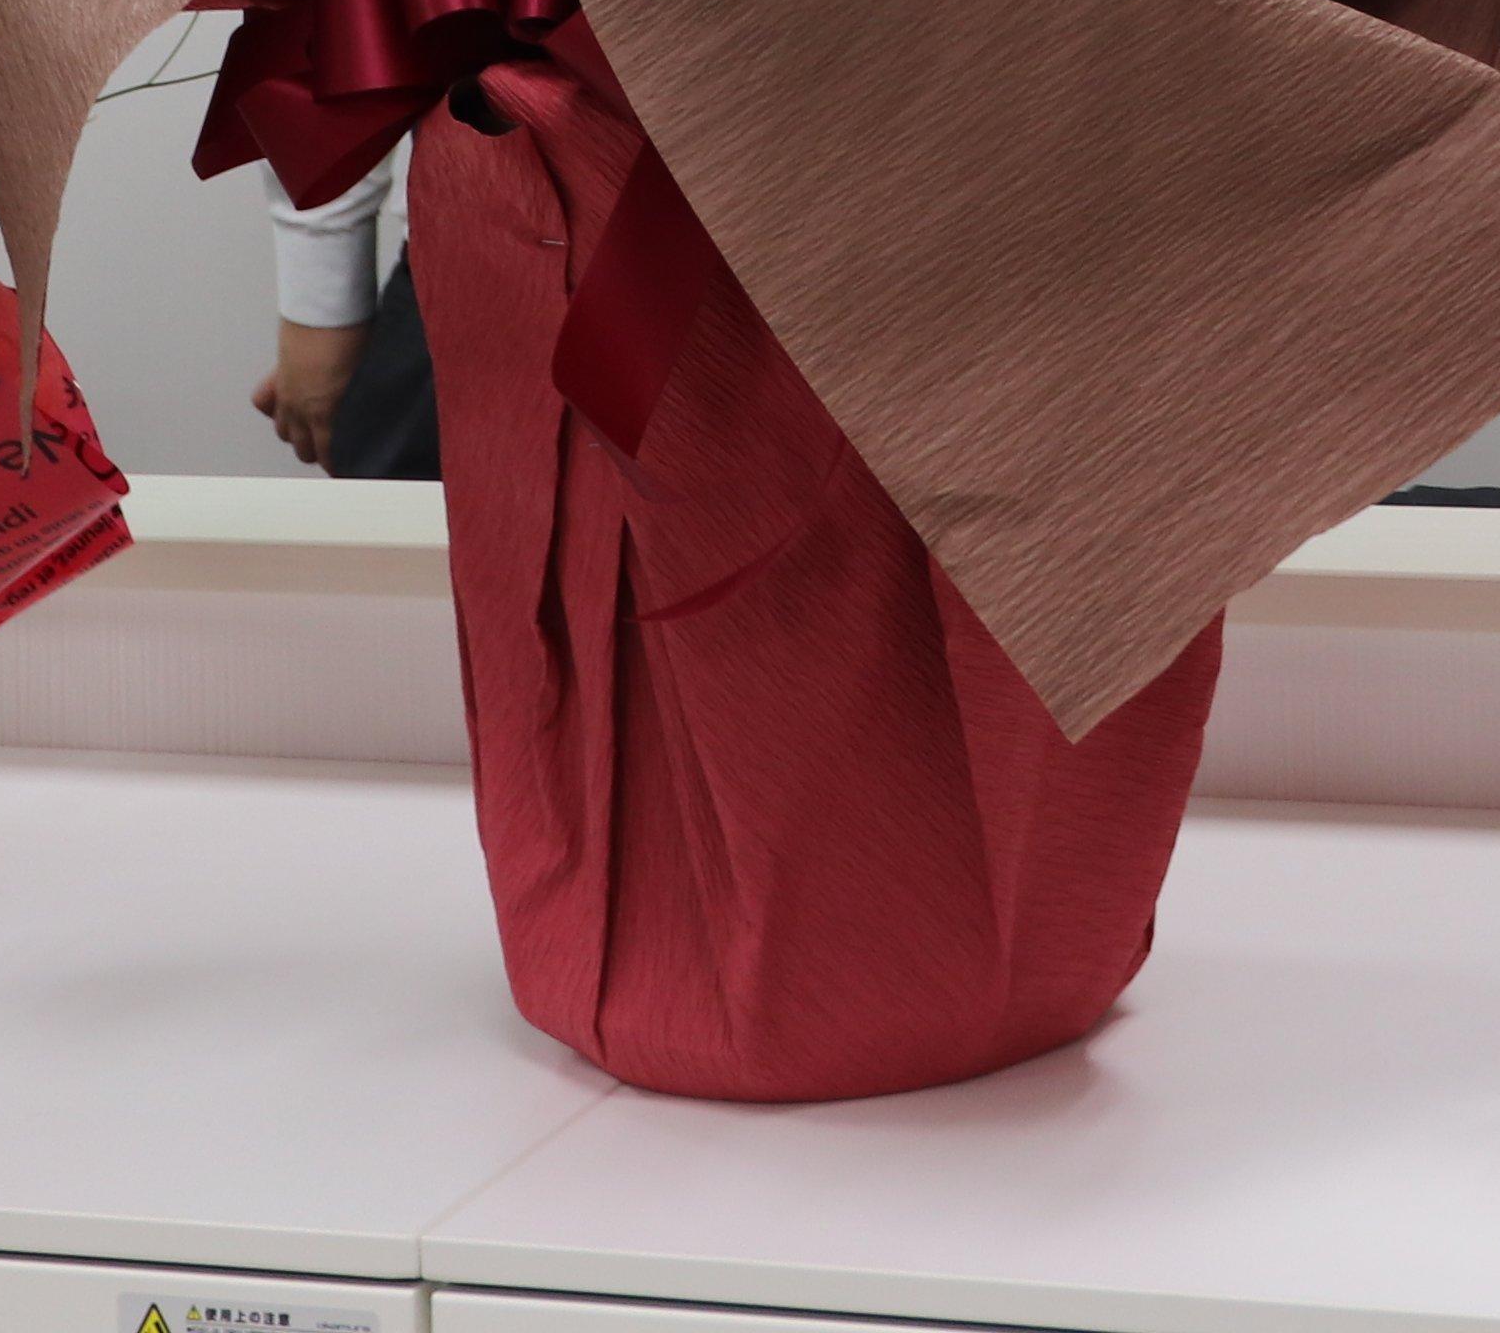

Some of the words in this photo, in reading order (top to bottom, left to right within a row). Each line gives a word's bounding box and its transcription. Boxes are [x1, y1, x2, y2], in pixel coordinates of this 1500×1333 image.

[204, 1307, 291, 1326] 使用上の注意
